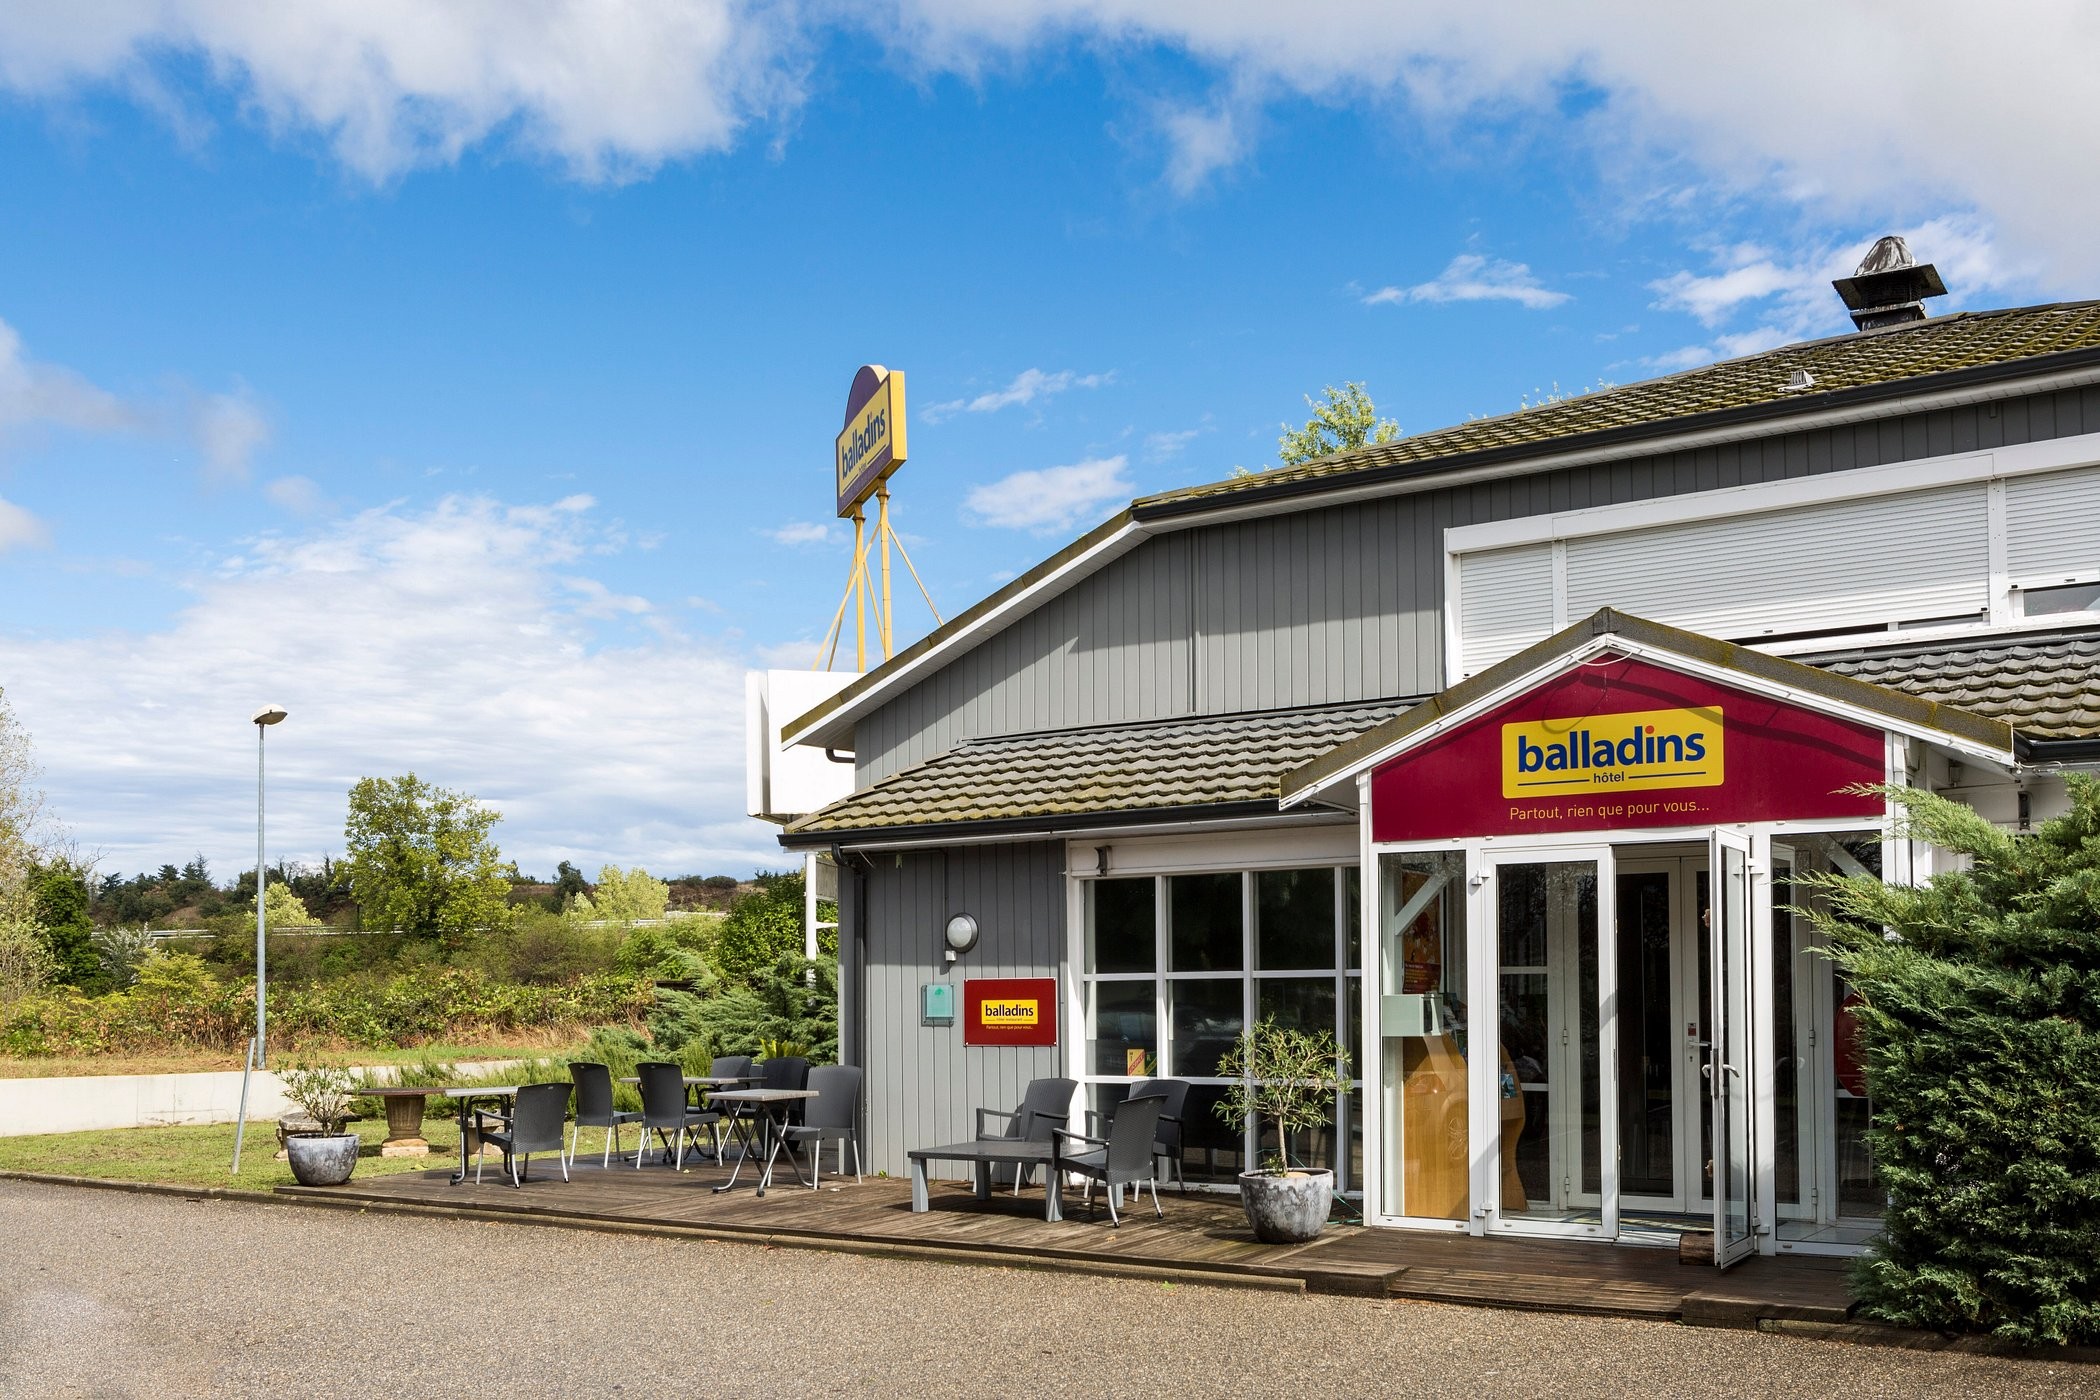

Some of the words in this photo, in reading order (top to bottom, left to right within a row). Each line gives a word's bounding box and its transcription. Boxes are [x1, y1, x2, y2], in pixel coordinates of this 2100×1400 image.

[841, 408, 886, 480] balladins
[1518, 725, 1706, 773] balladins
[1593, 771, 1625, 784] hôtel
[1510, 807, 1563, 820] Partout,
[1567, 804, 1594, 817] rien
[1598, 804, 1623, 819] que
[1627, 802, 1659, 818] pour
[1663, 801, 1710, 813] vous...
[985, 1004, 1034, 1016] balladins
